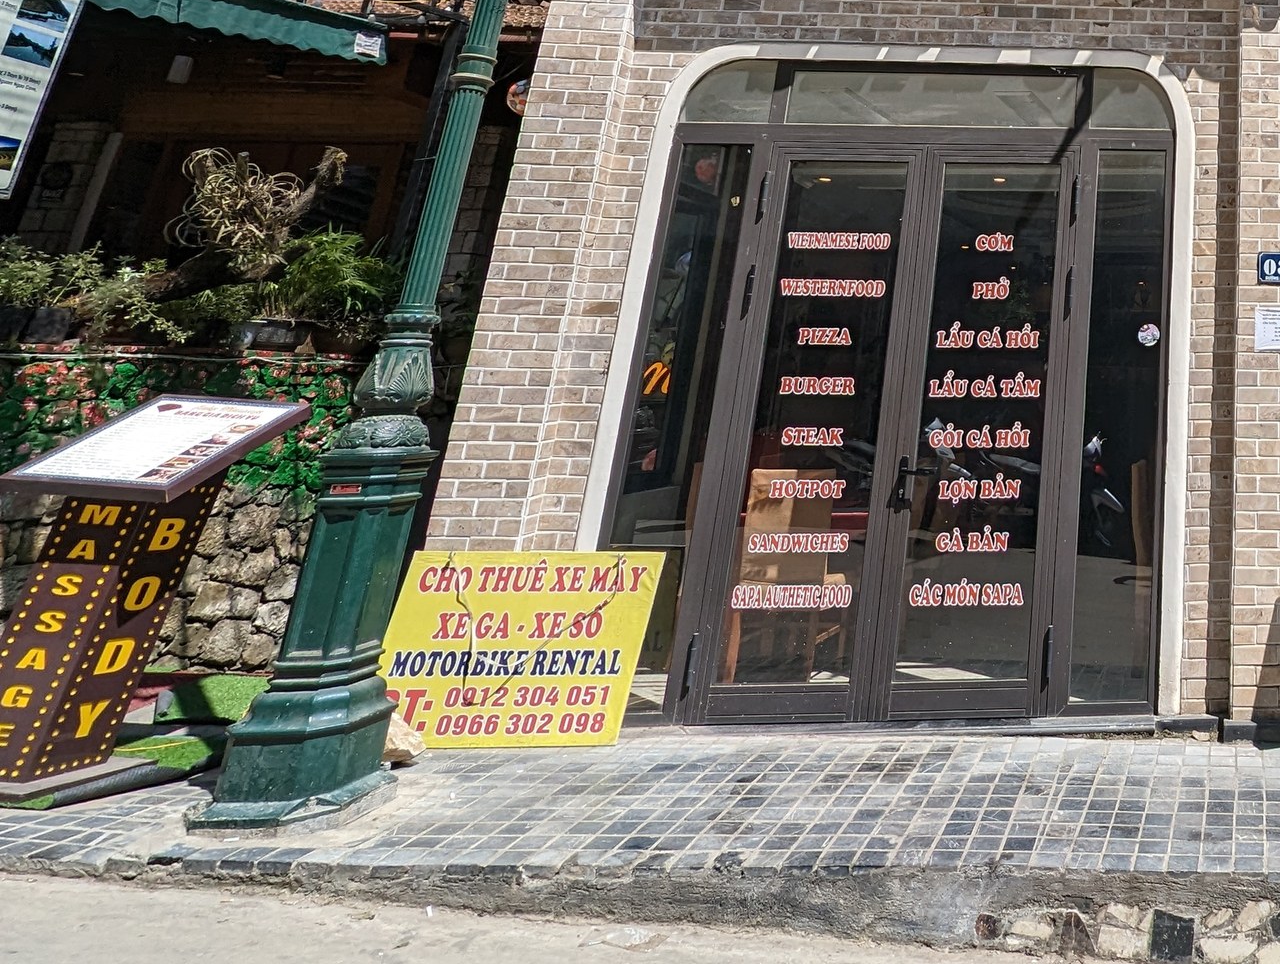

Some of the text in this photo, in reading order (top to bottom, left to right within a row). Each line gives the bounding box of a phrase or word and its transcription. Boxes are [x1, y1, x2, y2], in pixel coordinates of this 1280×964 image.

[788, 231, 891, 250] VIETNAMESE FOOD
[975, 232, 1014, 252] CƠM
[972, 276, 1010, 300] PHỞ
[798, 327, 852, 346] PIZZA
[936, 321, 1040, 348] LẨU CÁ HỒI
[780, 376, 855, 395] BURGER
[929, 369, 1041, 397] LẨU CÁ TẦM
[781, 427, 844, 446] STEAK
[929, 421, 1030, 448] GỎI CÁ HỒI
[769, 479, 846, 498] HOTPOT
[938, 473, 1021, 504] LỢN BẢN
[748, 533, 849, 553] SANDWICHES
[935, 525, 1010, 552] GÀ BẢN
[418, 559, 648, 594] CHO THUÊ XE MÁY
[731, 585, 853, 609] SAPA AUTHETIC FOOD
[909, 577, 1024, 606] CÁC MÓN SAPA
[74, 517, 187, 739] BODY
[432, 612, 473, 640] XE
[475, 611, 509, 640] GA
[528, 611, 569, 639] XE
[388, 649, 621, 677] MOTORBIKE RENTAL
[443, 685, 509, 708] 0912
[512, 685, 560, 707] 304
[565, 685, 611, 707] 051
[435, 712, 607, 736] 0966 302 098
